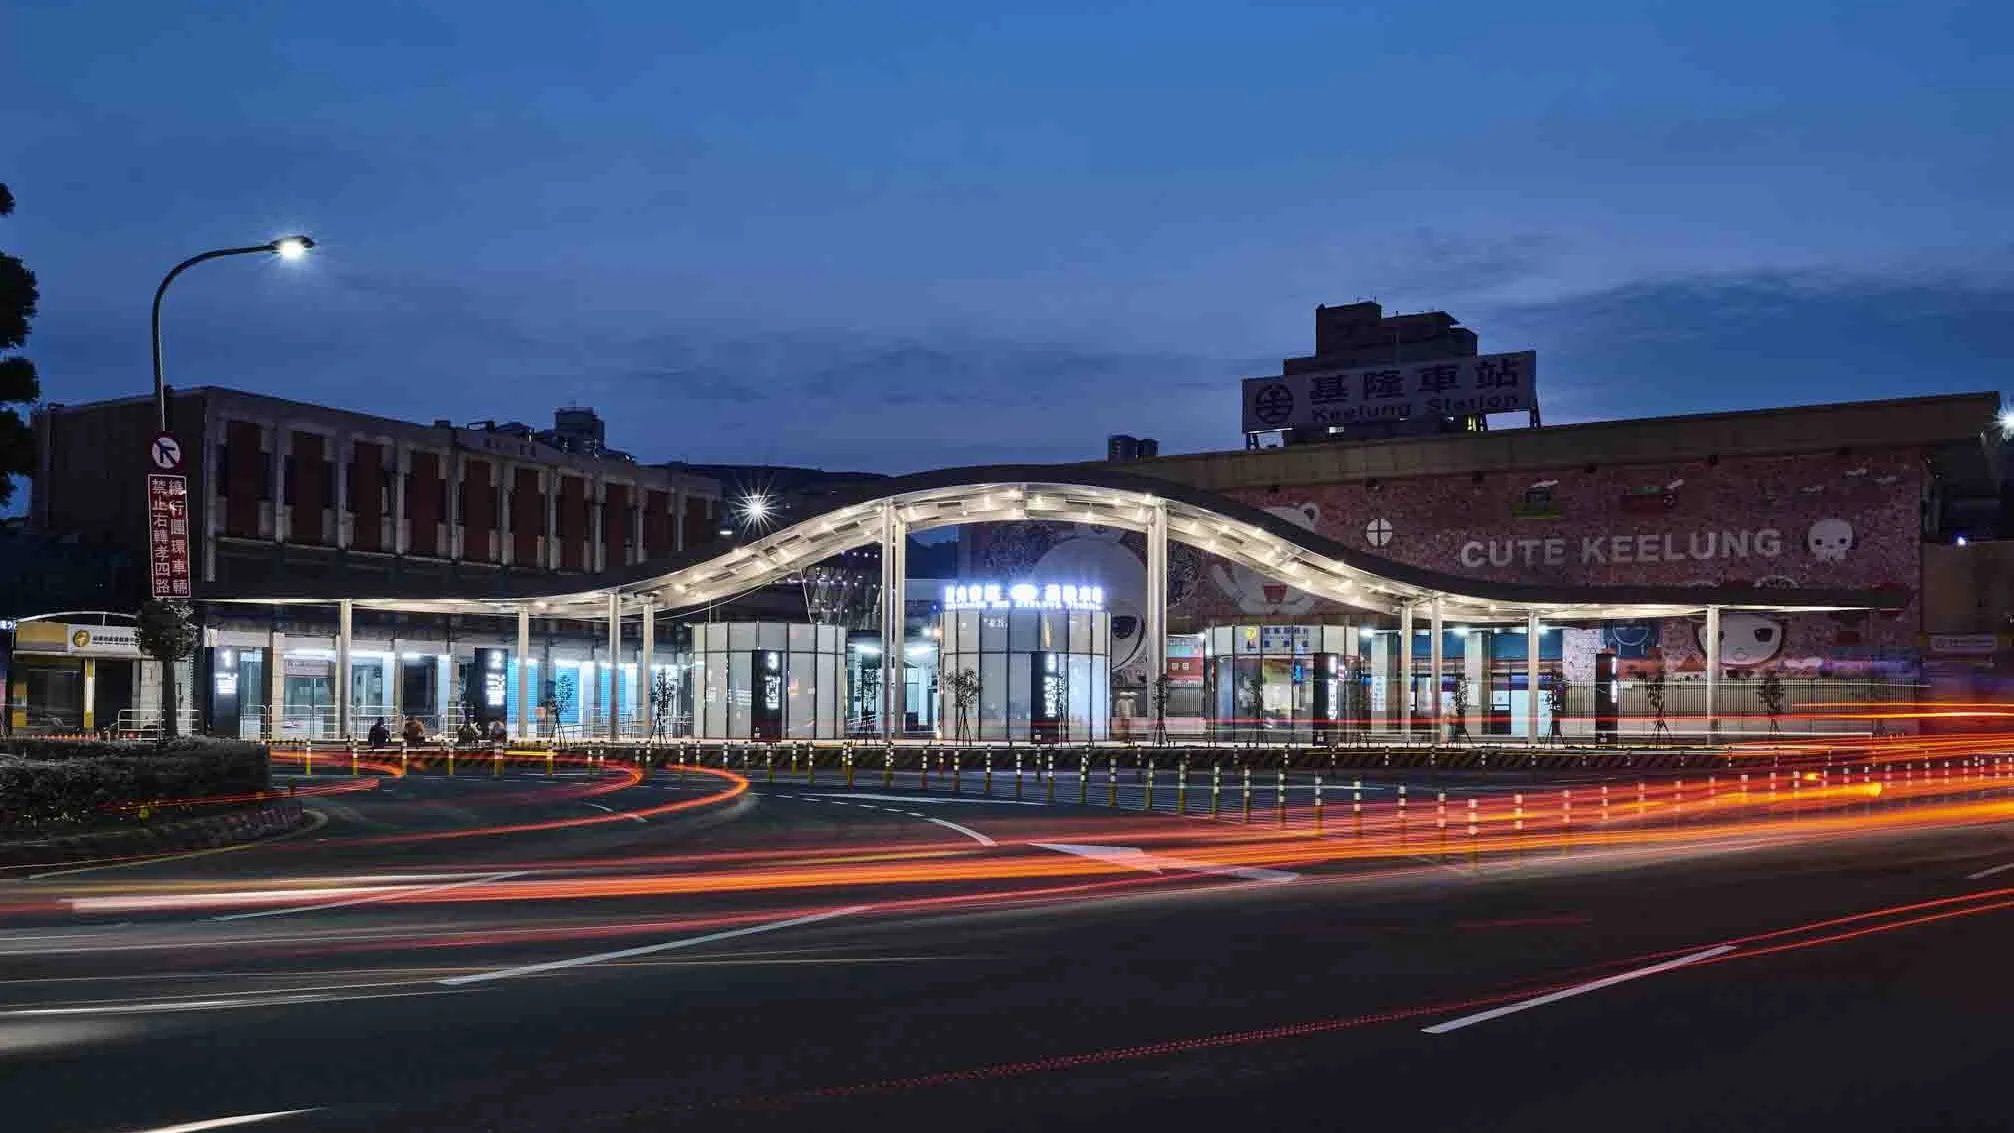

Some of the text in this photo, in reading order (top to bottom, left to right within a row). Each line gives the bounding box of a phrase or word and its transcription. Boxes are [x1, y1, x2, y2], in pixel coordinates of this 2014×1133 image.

[1310, 358, 1521, 404] 基隆車站
[1311, 394, 1519, 424] Keelung Station
[151, 478, 171, 594] 禁止右轉孝四路
[1460, 527, 1782, 568] CUTE KEELUNG
[221, 649, 232, 667] 1
